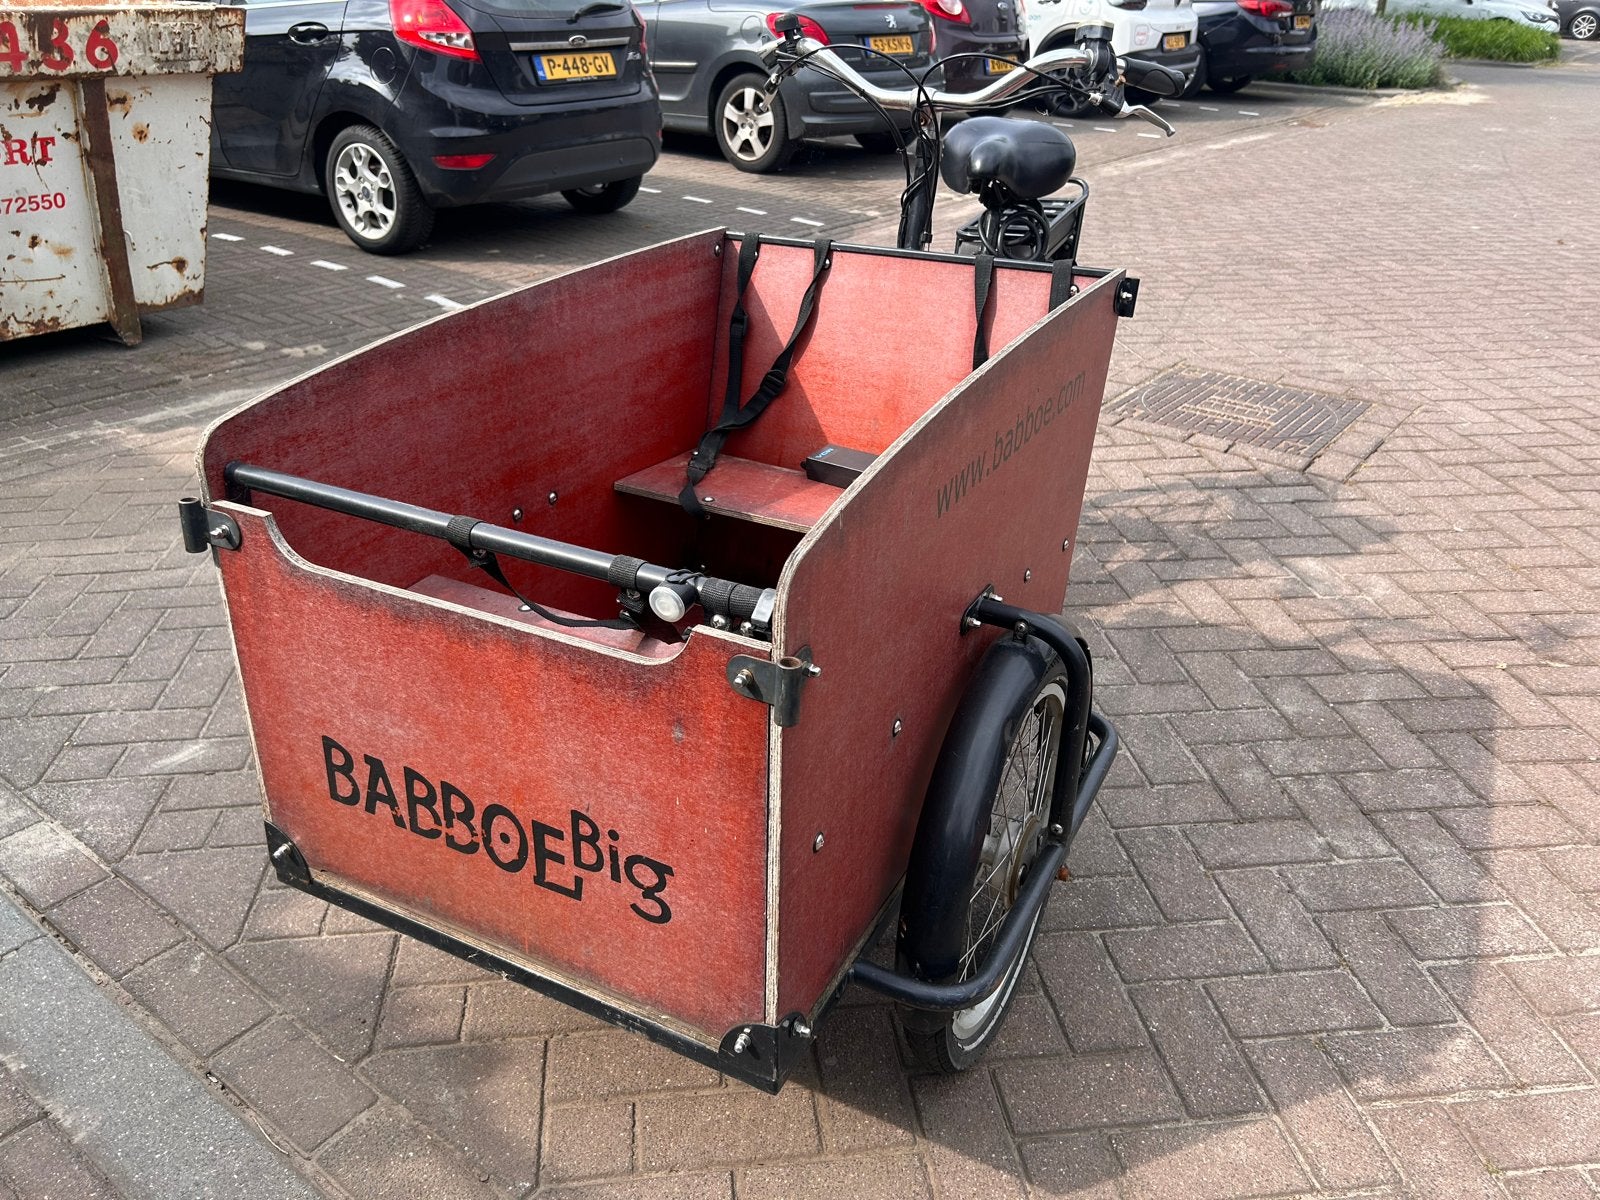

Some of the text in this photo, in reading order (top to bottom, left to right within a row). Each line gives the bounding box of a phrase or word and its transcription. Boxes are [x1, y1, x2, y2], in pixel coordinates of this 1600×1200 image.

[547, 56, 609, 76] P-448-GV
[0, 137, 56, 166] RT
[0, 192, 66, 215] 72550
[936, 371, 1086, 519] www.babboe.com
[321, 735, 675, 924] BABBOE Big
